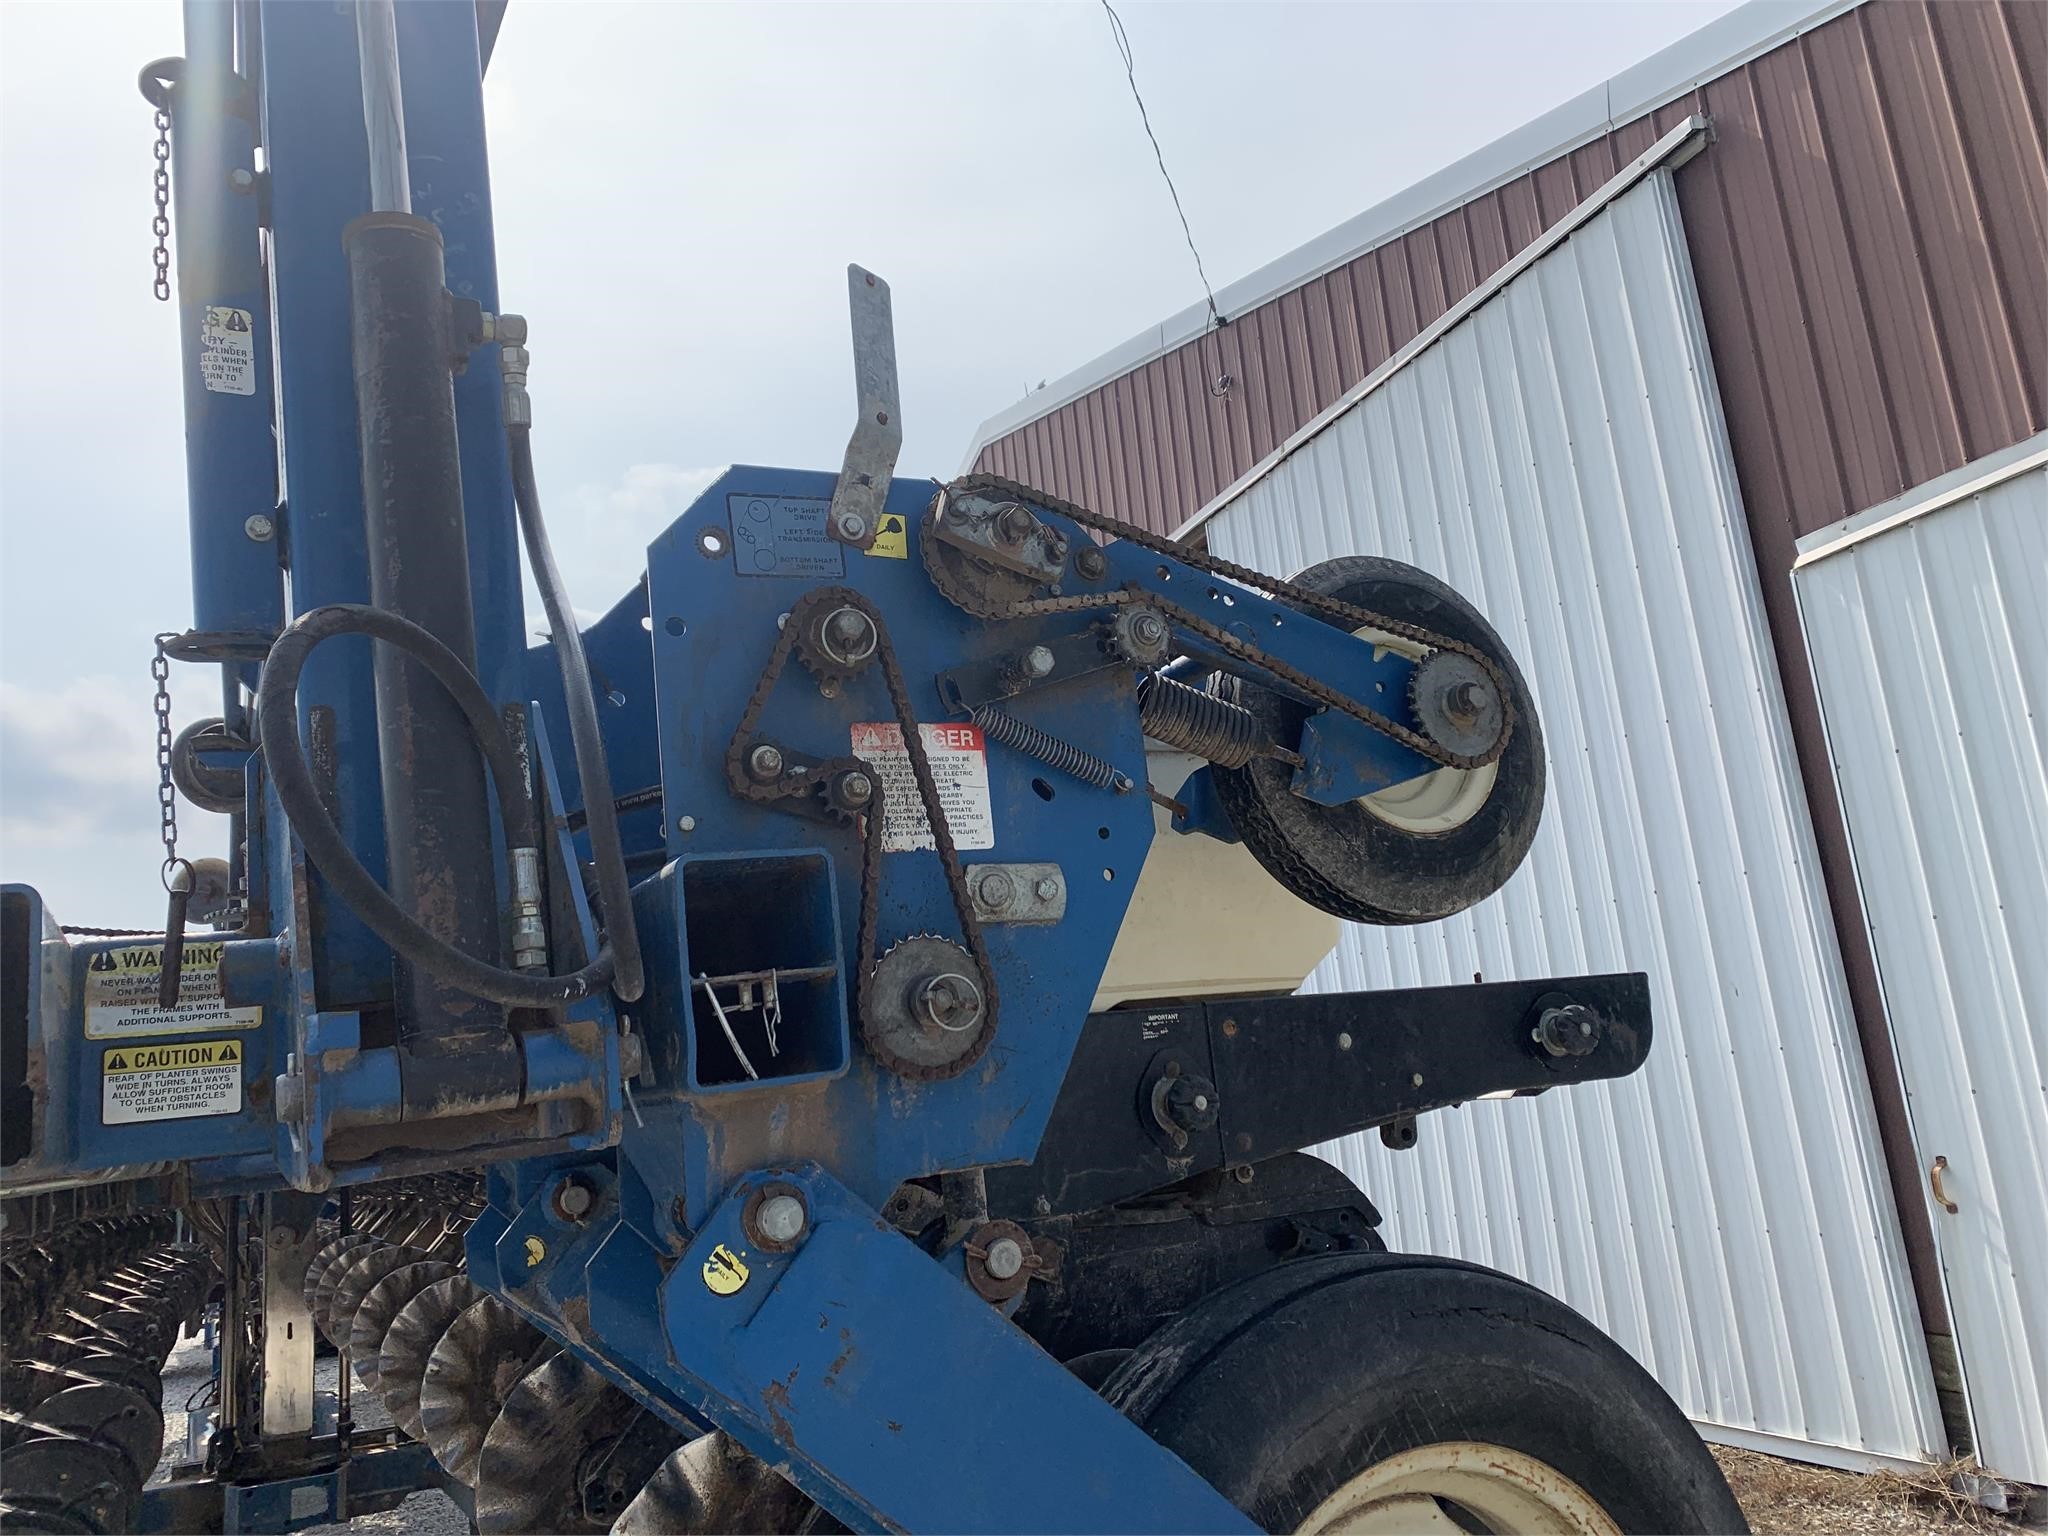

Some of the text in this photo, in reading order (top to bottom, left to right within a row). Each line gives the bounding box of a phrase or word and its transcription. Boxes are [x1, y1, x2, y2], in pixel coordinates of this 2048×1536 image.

[208, 346, 247, 357] YLINDER
[221, 356, 248, 365] WHEN
[227, 365, 243, 374] THE
[226, 374, 237, 382] TO
[806, 528, 824, 536] SIDE
[122, 945, 224, 968] WAIN
[101, 977, 133, 987] NEVER
[180, 974, 201, 982] DER
[203, 973, 217, 981] OR
[117, 988, 131, 996] ON
[100, 998, 137, 1008] RAISED
[131, 1003, 219, 1015] THE FRAMES WITH
[117, 1011, 232, 1026] ADDITIONAL SUPPORTS.
[1148, 1013, 1178, 1021] IMPORTANT
[134, 1047, 213, 1068] CAUTION
[108, 1074, 135, 1083] REAR
[155, 1068, 199, 1079] PLANTER
[201, 1066, 238, 1076] SWINGS
[115, 1075, 231, 1091] WIDE IN TURNS. ALWAYS
[111, 1082, 234, 1099] ALLOW SUFFICIENT ROOM
[120, 1091, 226, 1107] TO CLEAR OBSTACLES
[135, 1105, 164, 1114] WHEN
[167, 1101, 210, 1111] TURNING.
